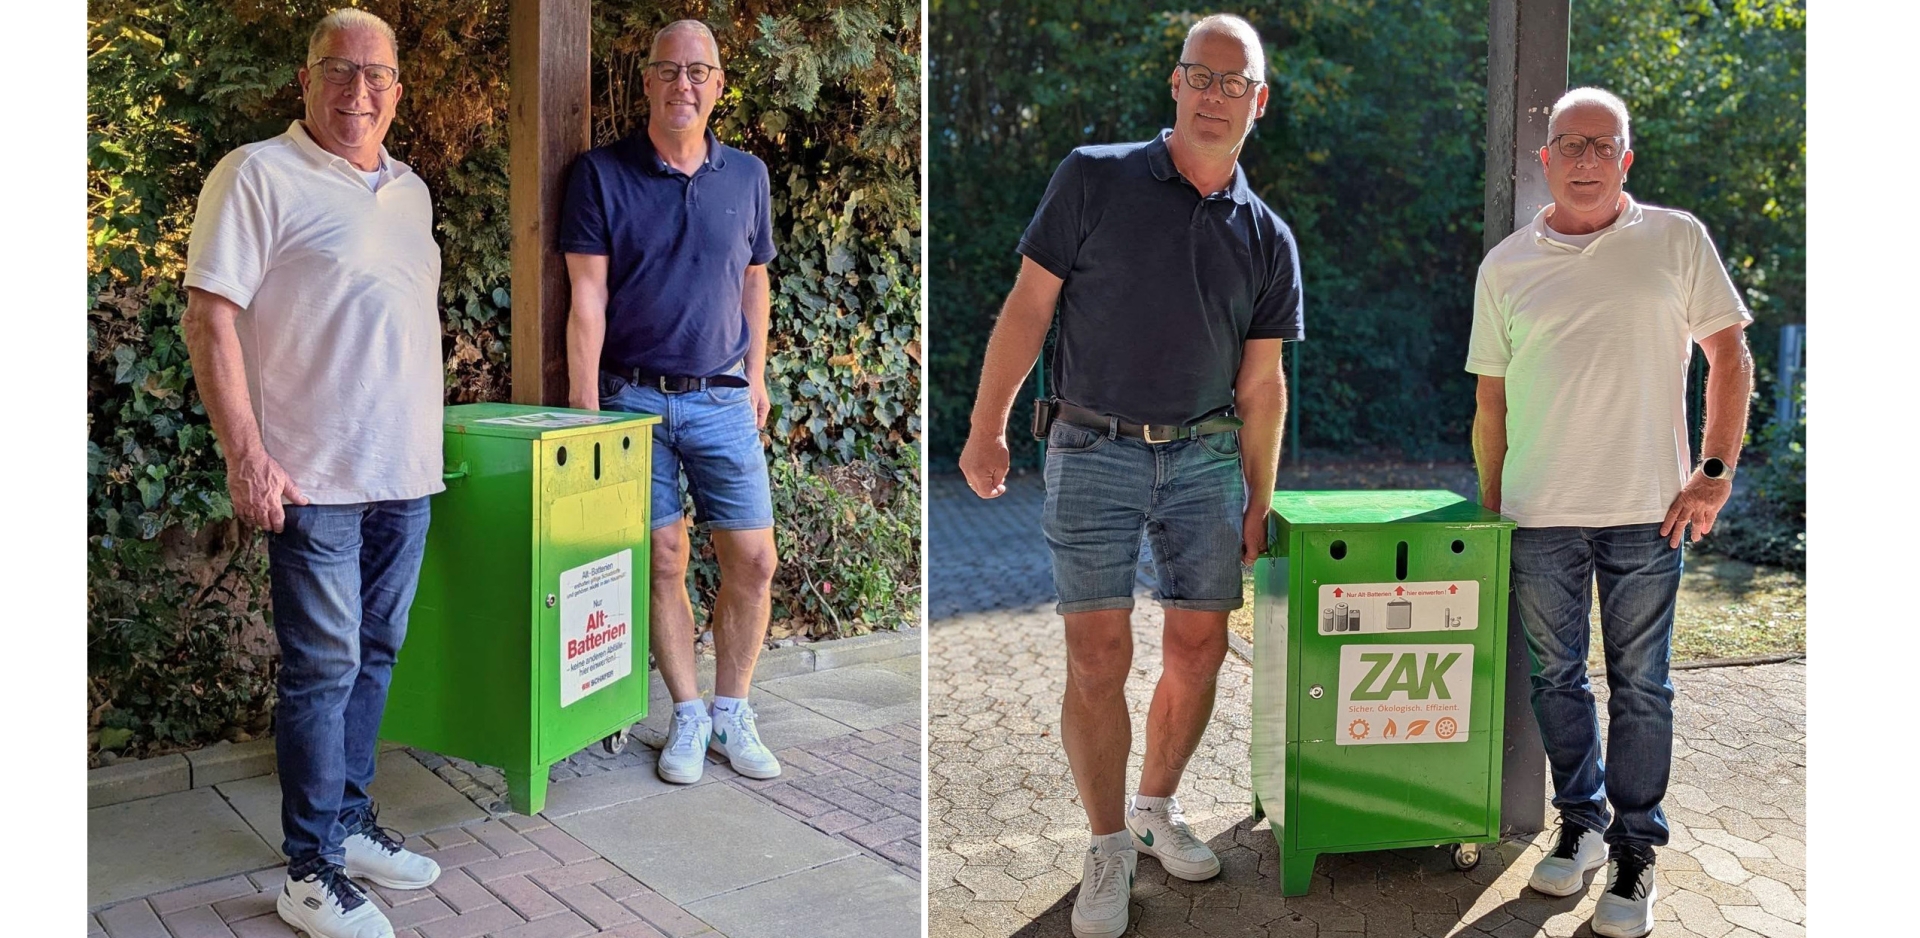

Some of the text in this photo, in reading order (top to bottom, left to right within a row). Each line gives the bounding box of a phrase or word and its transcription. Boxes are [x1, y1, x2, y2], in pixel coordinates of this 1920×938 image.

[593, 599, 603, 608] Nur
[586, 610, 608, 633] Alt-
[568, 622, 626, 660] Batterien
[571, 659, 585, 672] keine
[579, 666, 589, 676] hier
[1350, 652, 1463, 701] ZAK
[1348, 703, 1460, 714] Sicher. Ökologisch. Effizient.
